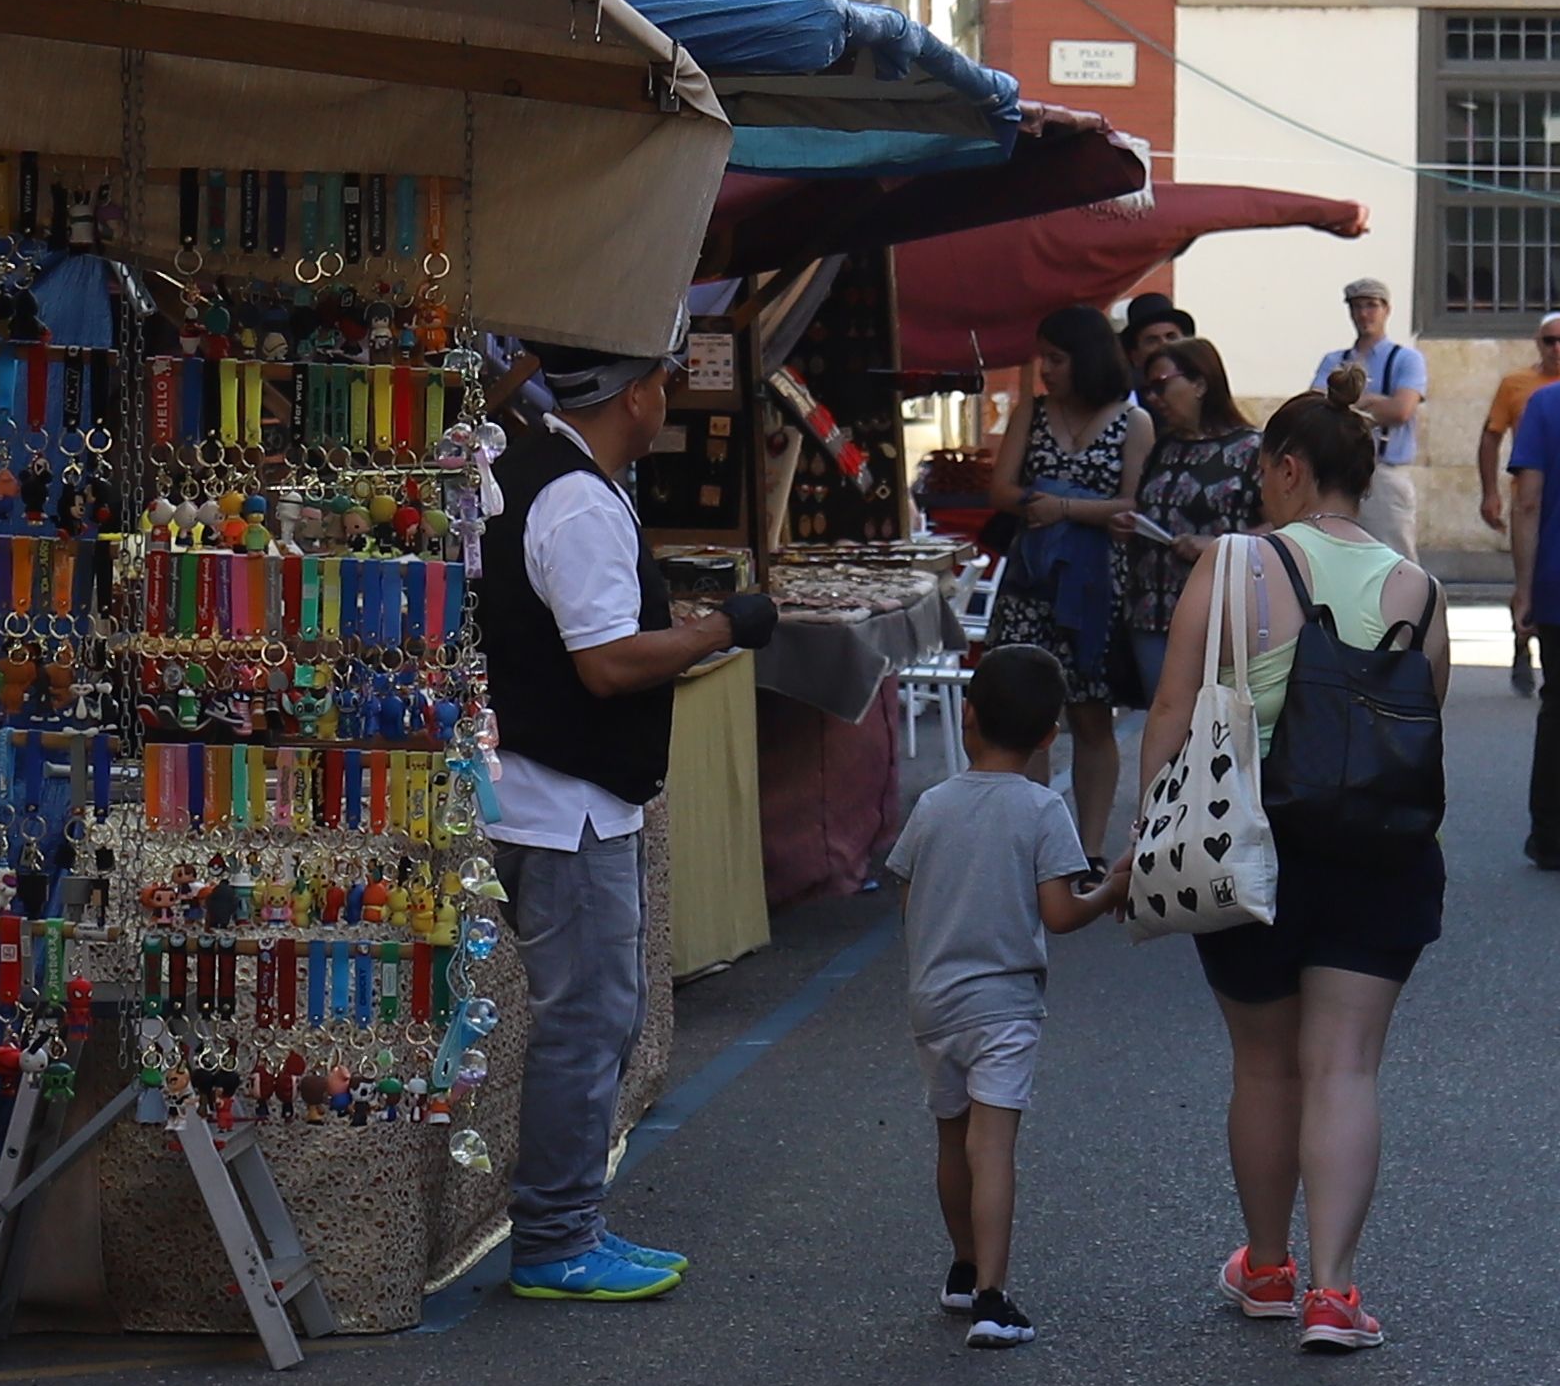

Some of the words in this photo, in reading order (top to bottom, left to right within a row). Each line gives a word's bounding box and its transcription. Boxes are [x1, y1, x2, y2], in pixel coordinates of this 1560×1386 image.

[295, 373, 304, 401] wars
[156, 380, 168, 429] HELLO
[293, 405, 302, 426] star
